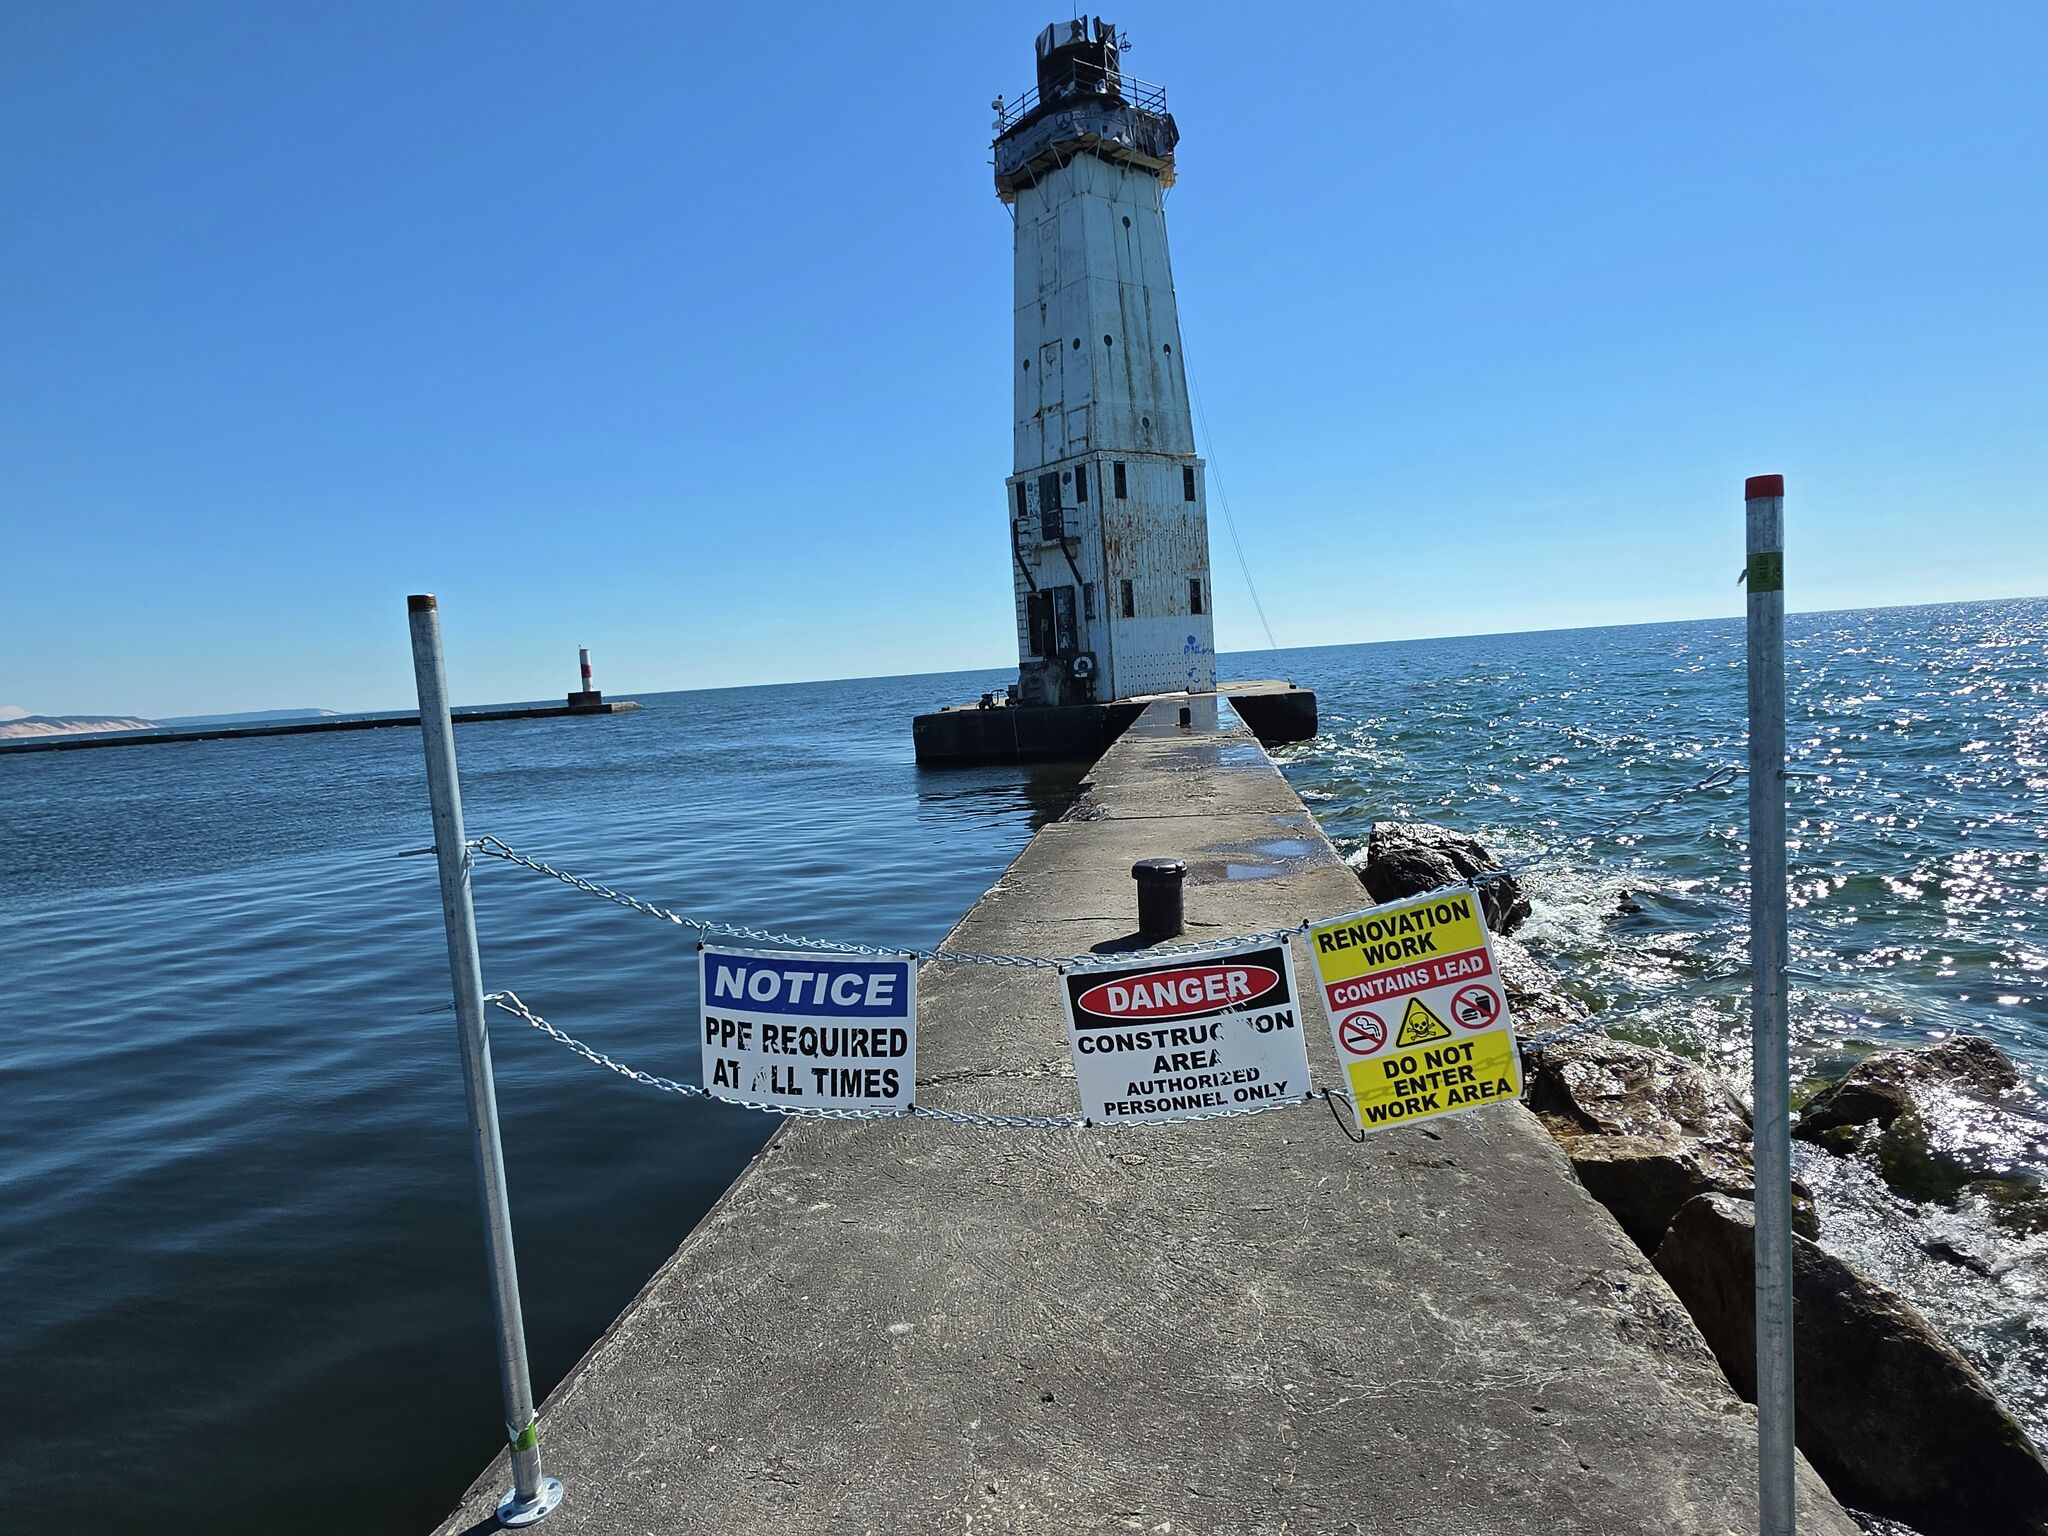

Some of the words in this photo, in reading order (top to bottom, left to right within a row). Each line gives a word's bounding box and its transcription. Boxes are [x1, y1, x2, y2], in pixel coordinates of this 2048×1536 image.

[1317, 899, 1471, 954] RENOVATION
[1362, 931, 1437, 967] WORK
[714, 965, 897, 1006] NOTICE
[1107, 970, 1253, 1013] DANGER
[1333, 970, 1430, 1005] CONTAINS
[1433, 955, 1484, 980] LEAD
[762, 1024, 908, 1059] REQUIRED
[1078, 1009, 1295, 1054] CONSTRUCON
[712, 1058, 741, 1089] AT
[811, 1067, 900, 1099] TIMES
[1126, 1066, 1260, 1096] AUTHORIZED
[1382, 1056, 1418, 1080] DO
[1424, 1042, 1475, 1070] NOT
[1393, 1064, 1477, 1098] ENTER
[1104, 1091, 1229, 1117] PERSONNEL
[1233, 1080, 1289, 1103] ONLY
[1365, 1092, 1441, 1124] WORK
[1447, 1077, 1513, 1107] AREA
